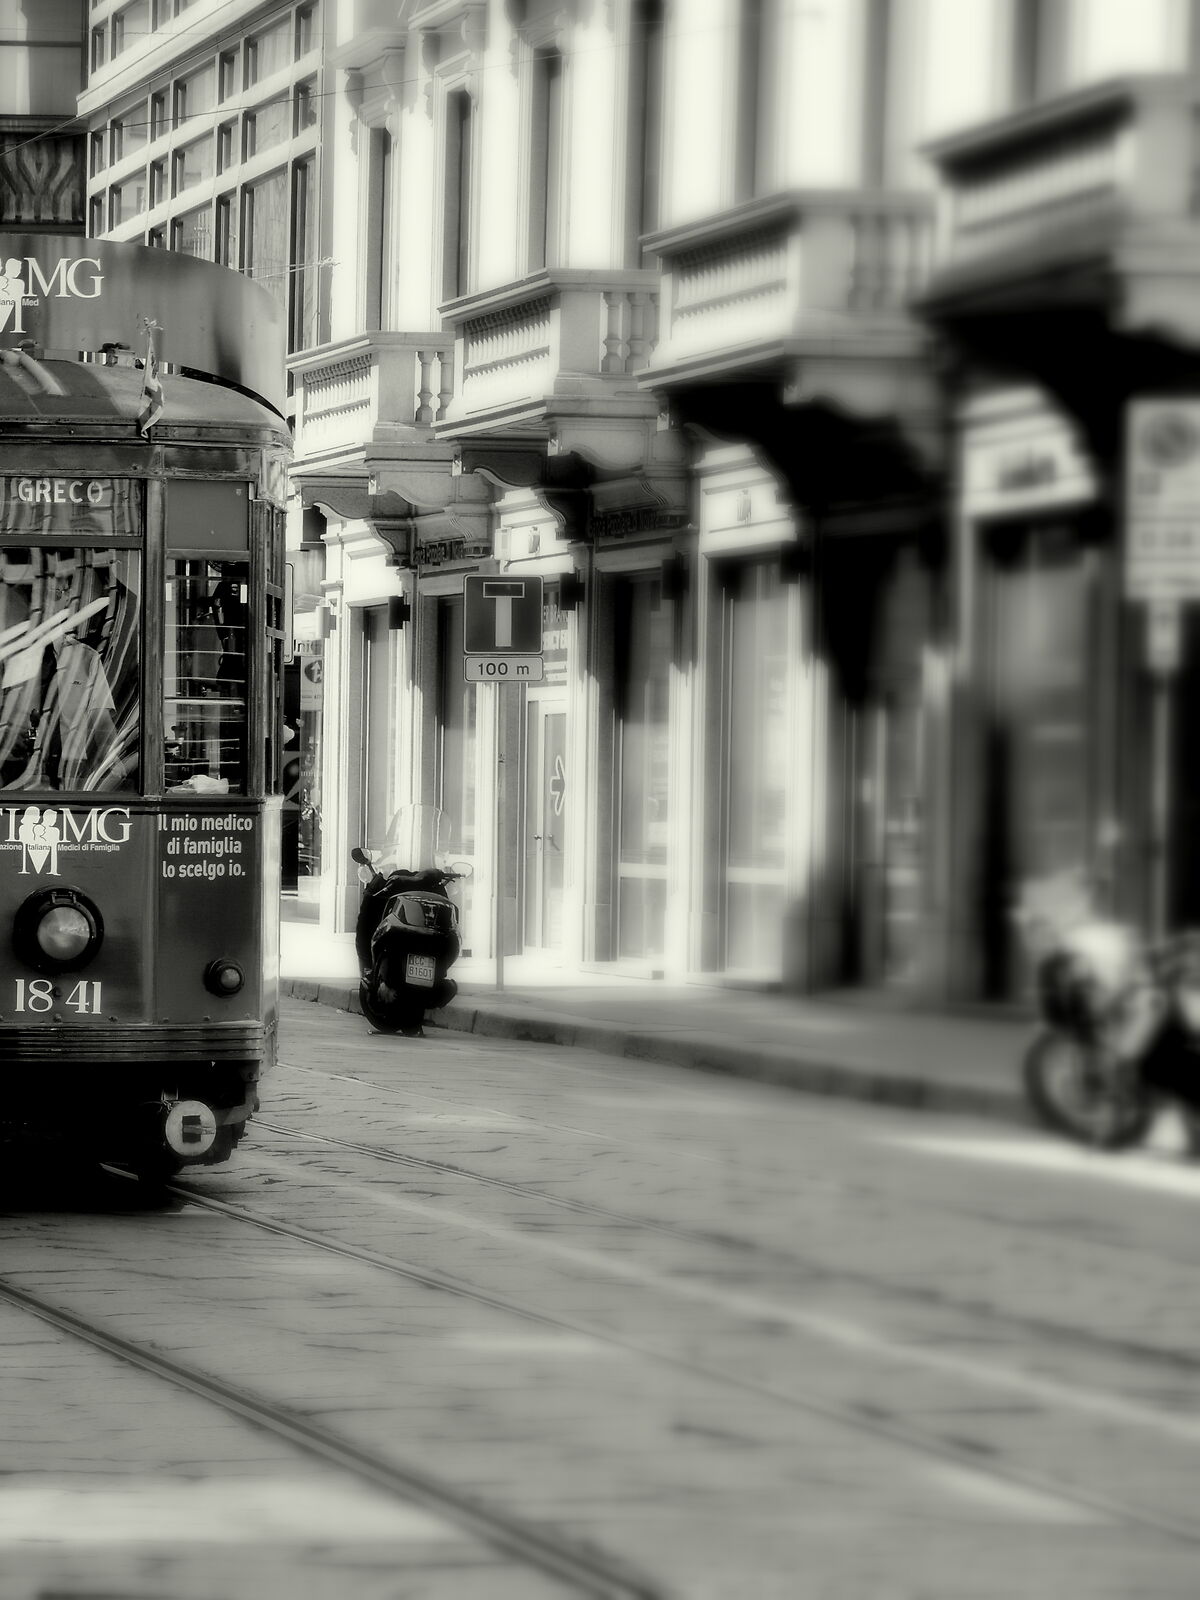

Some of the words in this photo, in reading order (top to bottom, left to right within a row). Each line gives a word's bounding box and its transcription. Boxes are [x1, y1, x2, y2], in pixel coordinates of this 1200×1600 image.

[18, 479, 104, 503] GRECO
[478, 662, 508, 676] 100
[516, 664, 530, 675] m
[157, 813, 168, 831] Il
[171, 814, 198, 831] mio
[201, 814, 253, 831] medico
[57, 843, 81, 851] Medici
[81, 843, 89, 851] di
[90, 843, 120, 853] Famiglia
[167, 837, 180, 855] di
[183, 836, 242, 858] famiglia
[162, 860, 176, 878] lo
[178, 860, 226, 881] scelgo
[228, 859, 246, 877] io.
